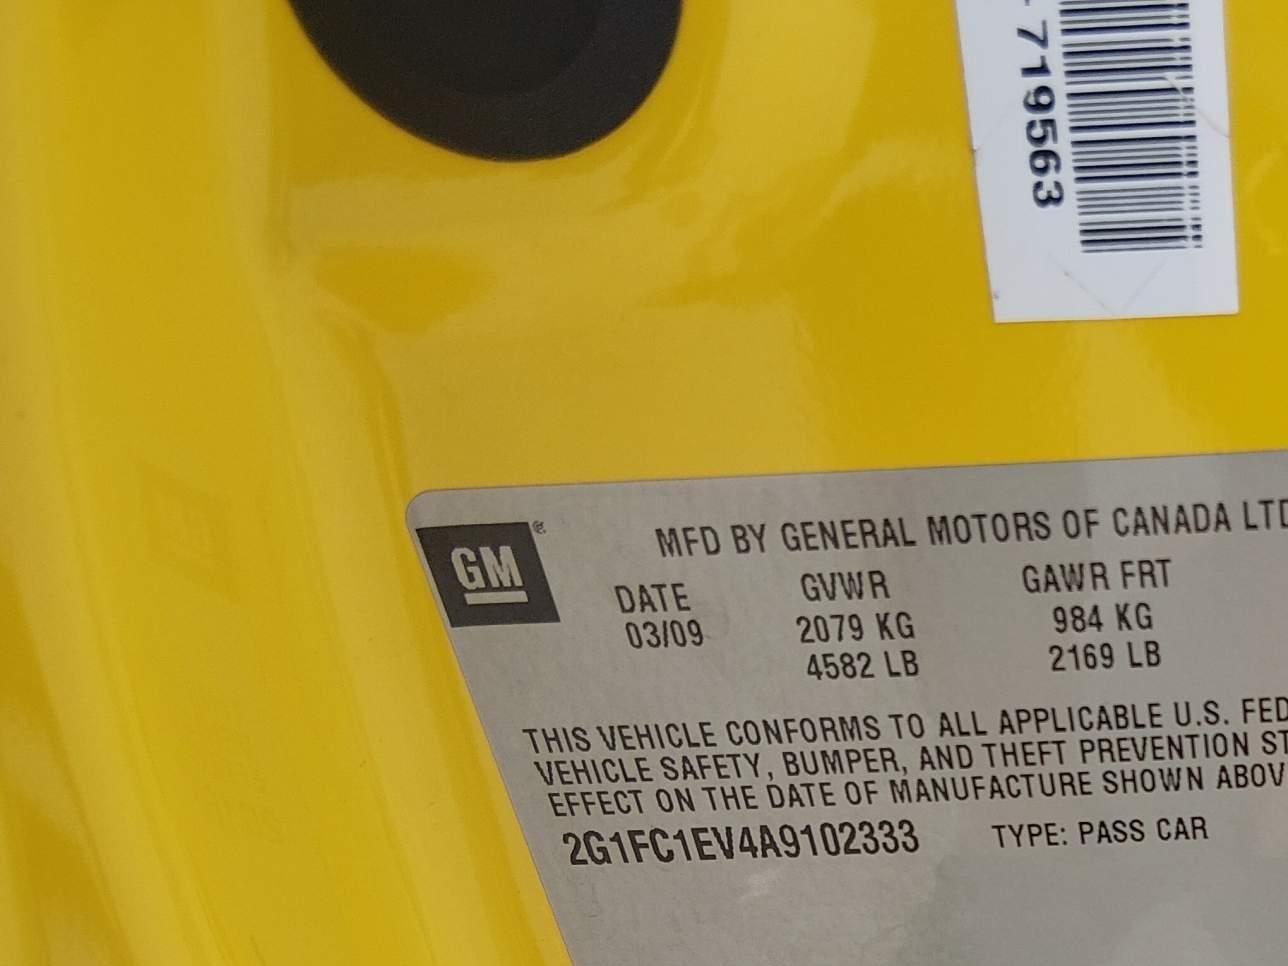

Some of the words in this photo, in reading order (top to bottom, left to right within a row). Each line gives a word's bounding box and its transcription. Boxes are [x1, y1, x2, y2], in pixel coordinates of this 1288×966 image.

[655, 526, 721, 557] MFD
[730, 524, 765, 554] BY
[781, 517, 916, 551] GENERAL
[926, 511, 1051, 545] MOTORS
[1062, 509, 1099, 539] OF
[1112, 502, 1232, 537] CANADA
[451, 546, 523, 590] GM
[1022, 562, 1110, 593] GAWR
[1120, 558, 1171, 589] FRT
[614, 583, 691, 613] DATE
[800, 570, 890, 602] GVWR
[625, 619, 704, 649] 03/09
[796, 613, 864, 643] 2079
[875, 611, 915, 640] KG
[1053, 604, 1104, 634] 984
[1115, 602, 1153, 631] KG
[807, 652, 875, 680] 4582
[884, 650, 919, 677] LB
[1049, 642, 1114, 672] 2169
[1127, 640, 1161, 668] LB
[522, 727, 591, 754] THIS
[596, 722, 717, 751] VEHICLE
[726, 715, 881, 746] CONFORMS
[888, 713, 925, 739] TO
[939, 711, 988, 738] ALL
[999, 703, 1163, 735] APPLICABLE
[1173, 700, 1229, 727] U.S.
[533, 757, 654, 786] VEHICLE
[660, 753, 773, 782] SAFETY,
[782, 747, 907, 776] BUMPER,
[920, 744, 973, 771] AND
[981, 740, 1067, 768] THEFT
[1079, 731, 1249, 764] PREVENTION
[548, 789, 644, 816] EFFECT
[655, 787, 696, 813] ON
[701, 785, 759, 811] THE
[766, 782, 836, 808] DATE
[844, 780, 878, 805] OF
[889, 766, 1093, 804] MANUFACTURE
[1102, 766, 1204, 794] SHOWN
[563, 819, 920, 865] 2G1FC1EV4A9102333
[991, 823, 1067, 848] TYPE:
[1078, 819, 1145, 845] PASS
[1156, 816, 1208, 841] CAR
